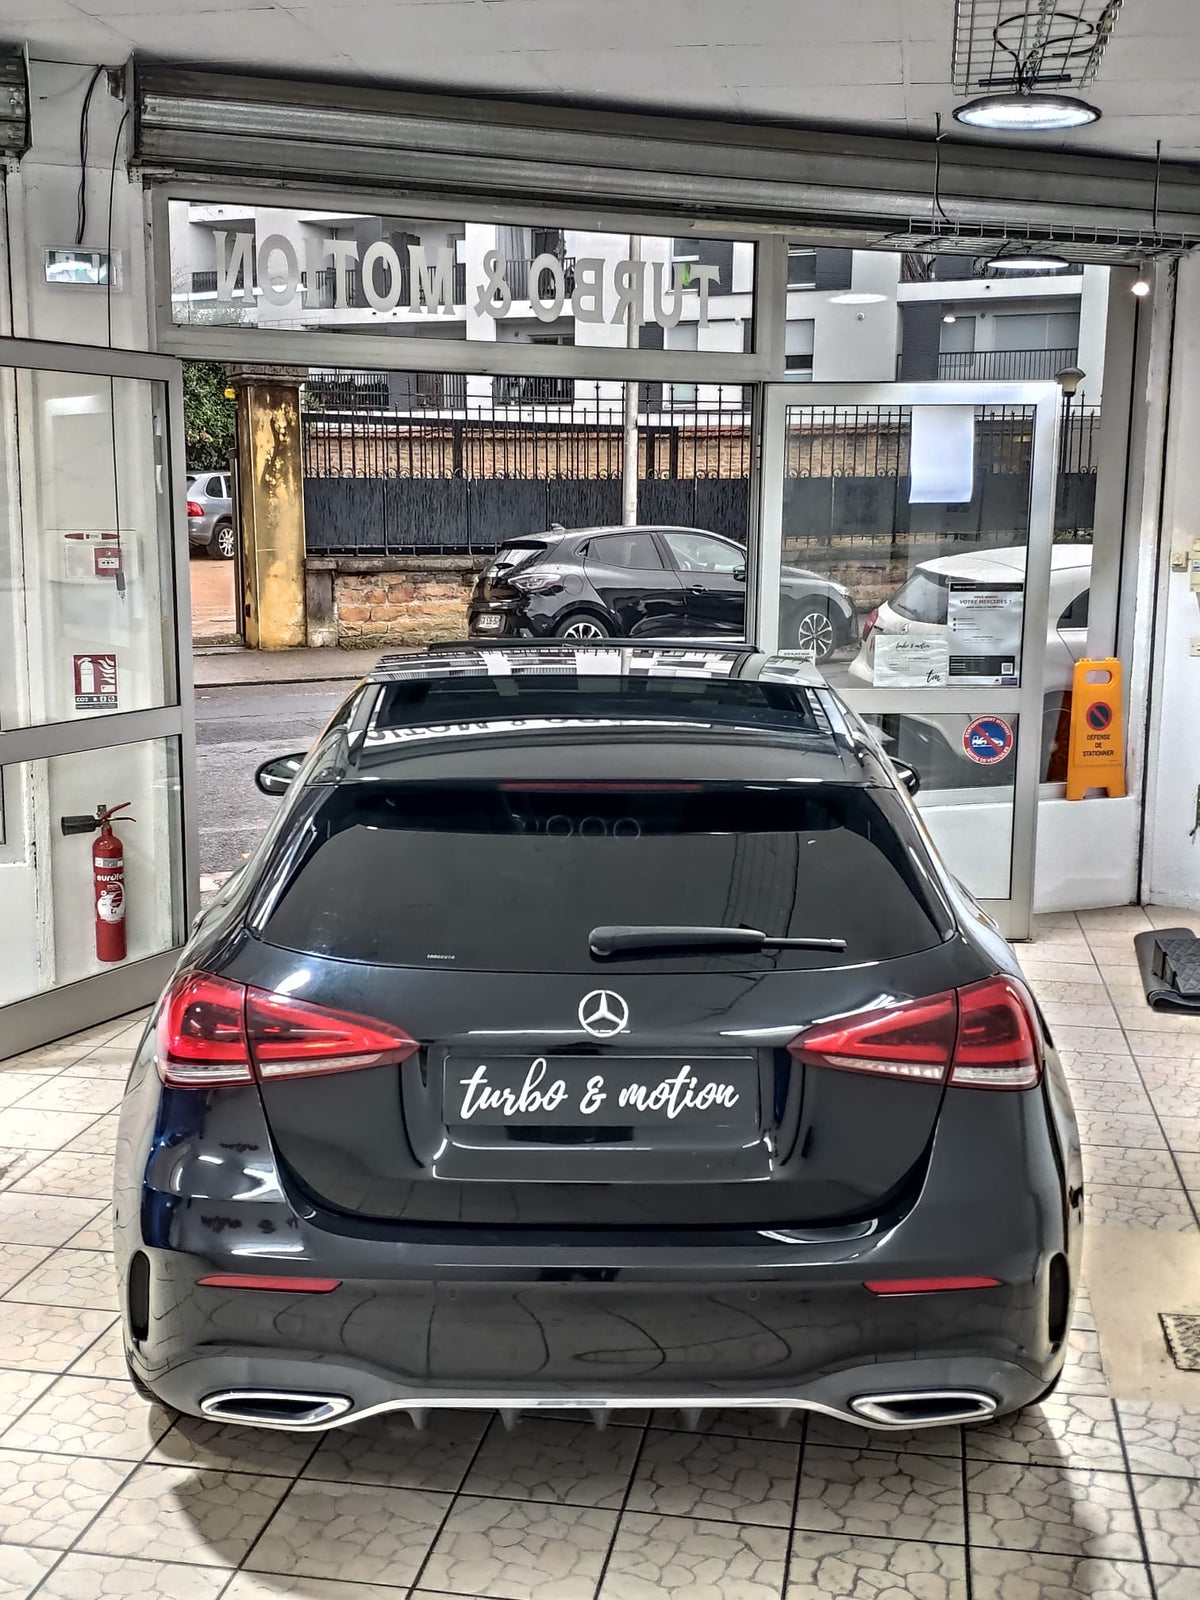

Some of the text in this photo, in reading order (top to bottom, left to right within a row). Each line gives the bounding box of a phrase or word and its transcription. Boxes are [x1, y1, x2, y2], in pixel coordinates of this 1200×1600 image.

[459, 1057, 739, 1119] turbo & motion
